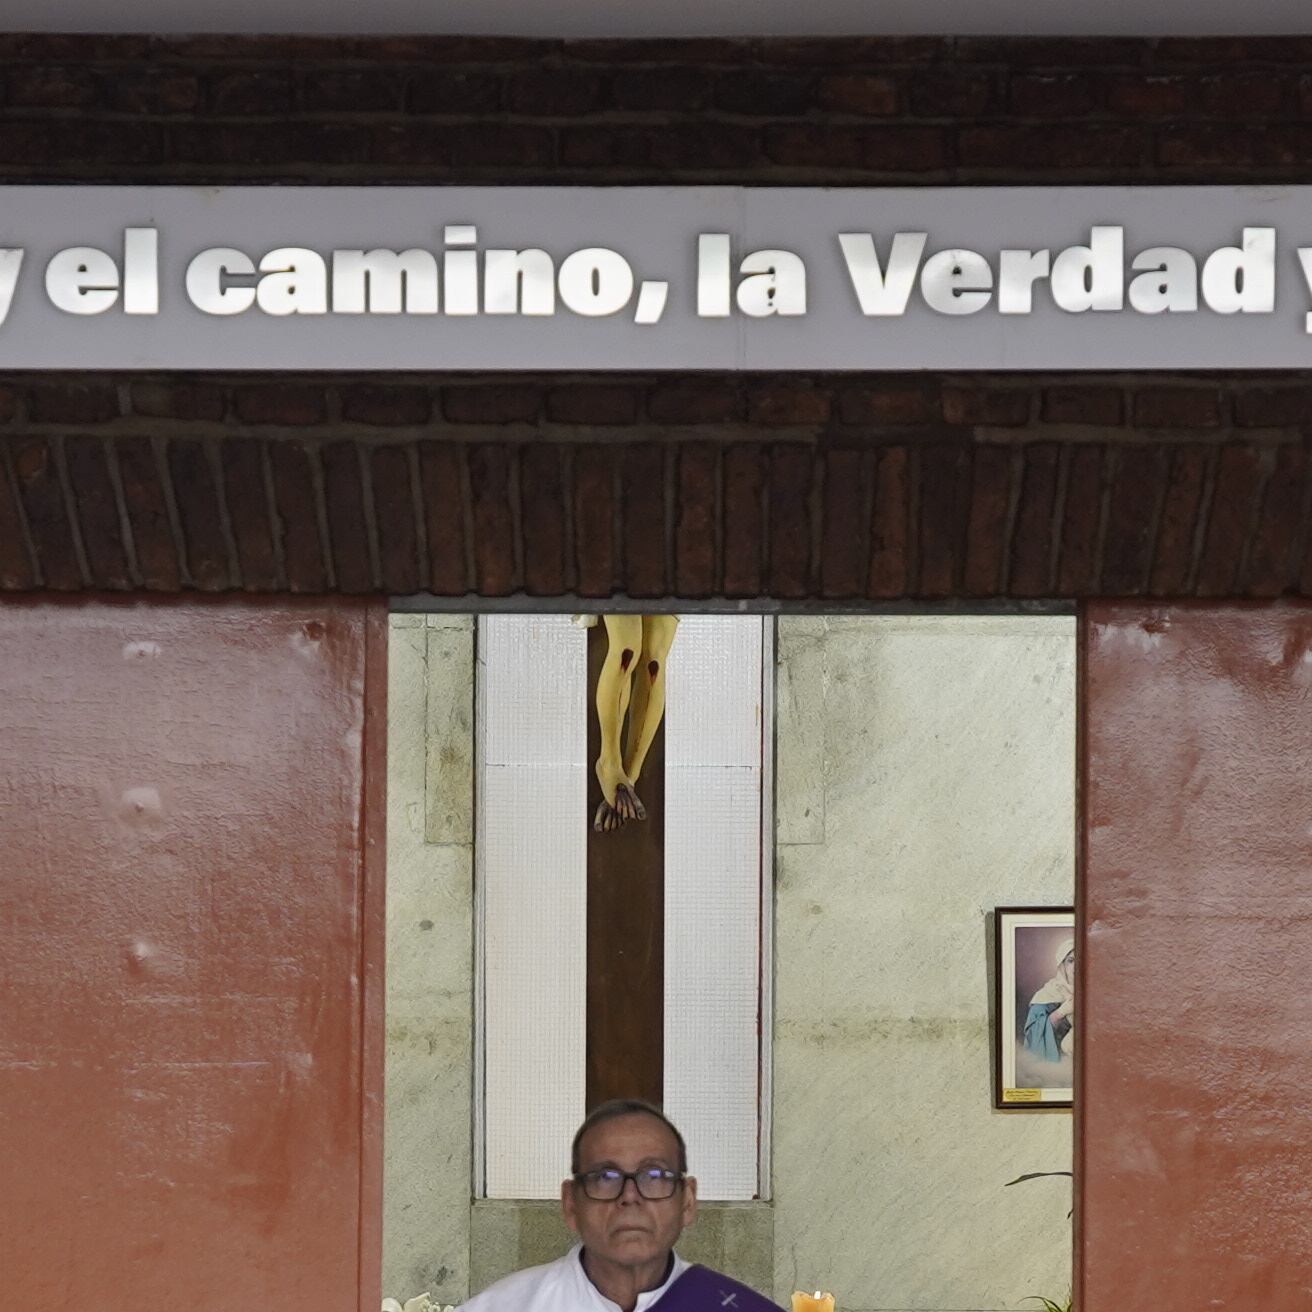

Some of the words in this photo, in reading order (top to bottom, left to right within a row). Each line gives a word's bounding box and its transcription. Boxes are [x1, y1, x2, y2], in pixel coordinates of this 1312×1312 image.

[45, 227, 159, 315] el
[186, 225, 668, 324] camino,
[698, 233, 807, 317] la
[838, 225, 1276, 315] Verdad
